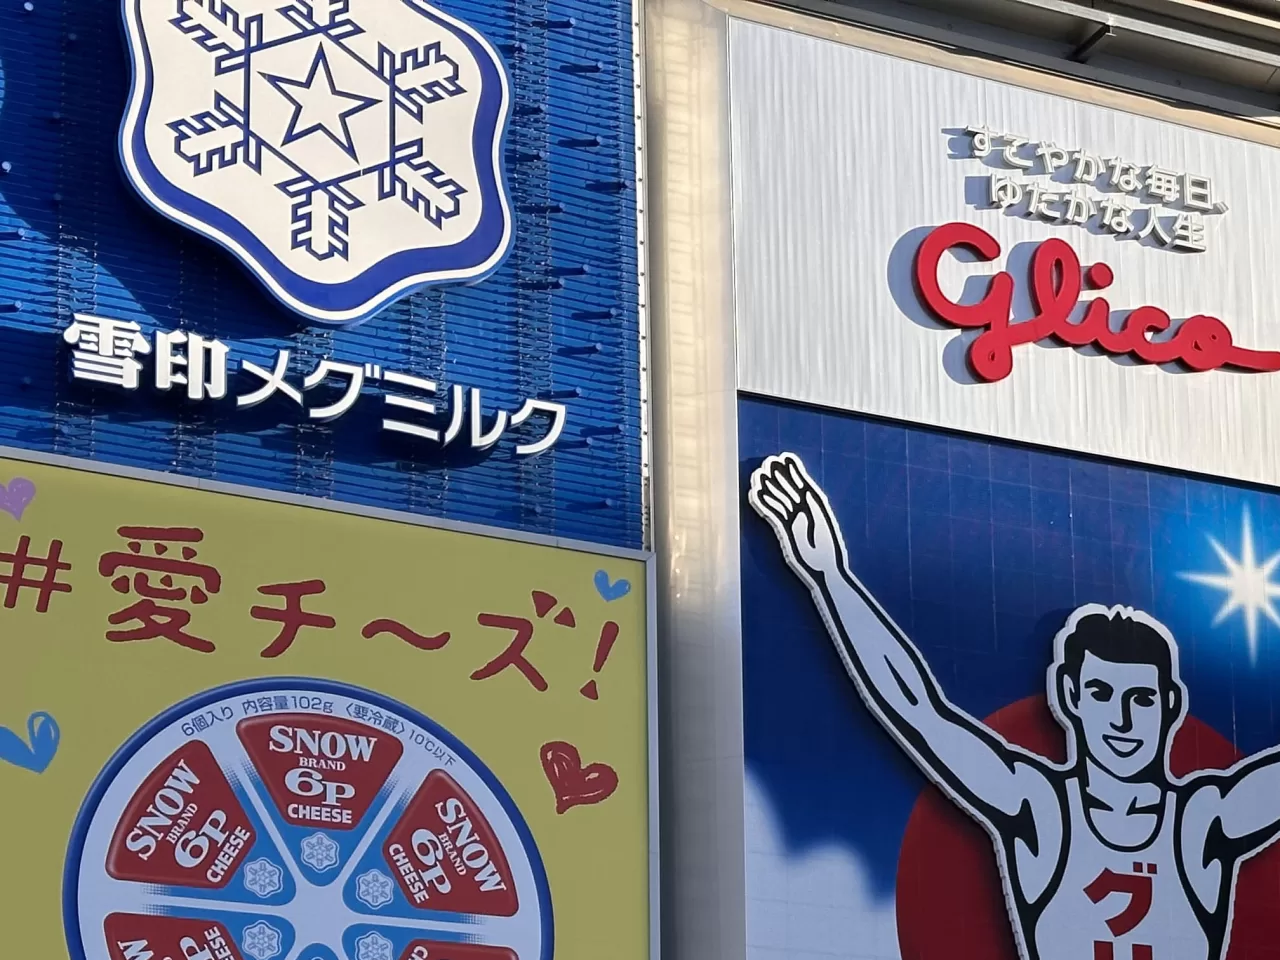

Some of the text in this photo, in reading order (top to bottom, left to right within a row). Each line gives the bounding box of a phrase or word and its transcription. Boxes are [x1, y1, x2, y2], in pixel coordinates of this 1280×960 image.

[988, 172, 1207, 253] ゆたかな人生
[62, 312, 568, 455] 雪印メグミルク
[269, 724, 378, 763] SNOW
[298, 757, 346, 772] BRAND
[125, 758, 201, 861] SNOW
[284, 767, 356, 806] 6P
[287, 803, 353, 825] CHEESE
[165, 802, 198, 844] BRAND
[174, 809, 229, 868] 6P
[434, 797, 507, 892] SNOW
[206, 825, 251, 883] CHEESE
[388, 843, 430, 904] CHEESE
[411, 828, 452, 894] 6P
[438, 832, 467, 876] BRAND
